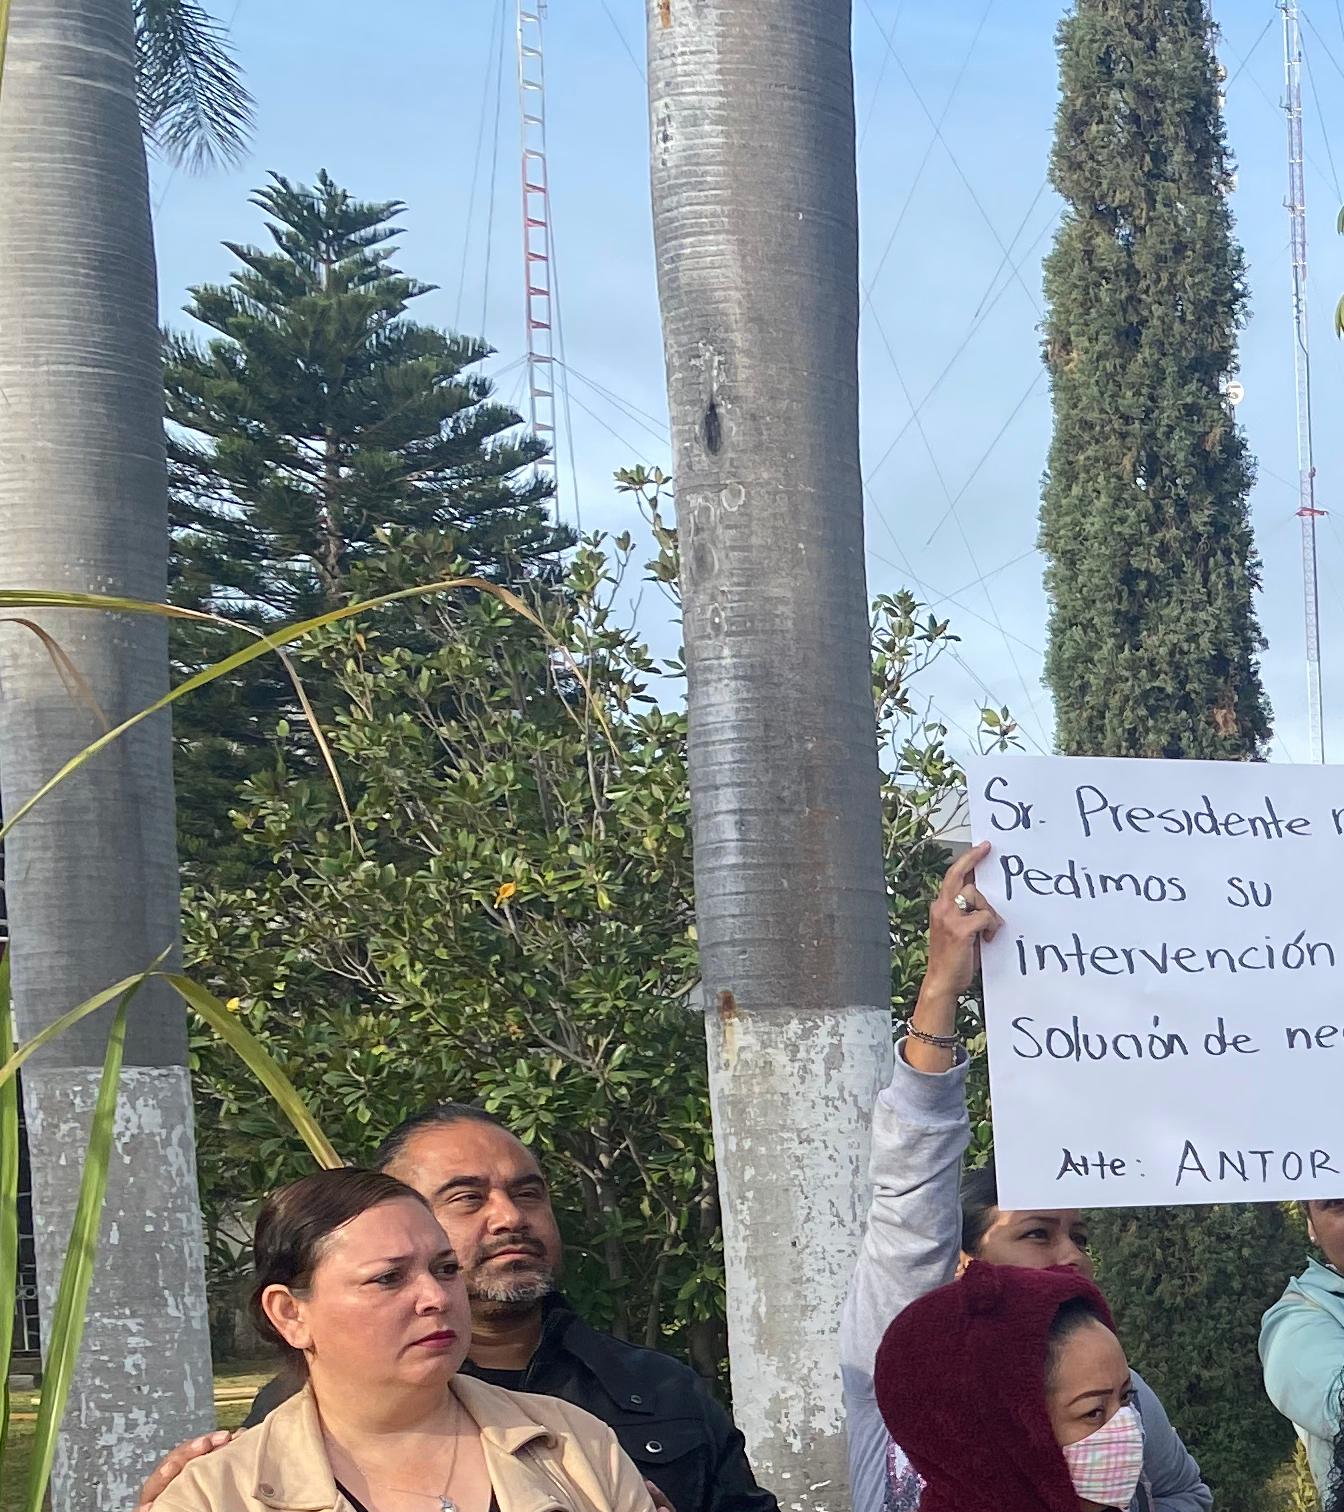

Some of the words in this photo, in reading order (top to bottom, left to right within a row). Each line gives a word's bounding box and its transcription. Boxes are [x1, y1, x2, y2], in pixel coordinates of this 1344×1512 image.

[984, 777, 1045, 832] Sr.
[1077, 785, 1311, 837] Presidente
[1000, 854, 1187, 902] Pedimos
[1227, 875, 1272, 907] su
[1015, 930, 1336, 975] intervención
[1204, 1018, 1260, 1055] de
